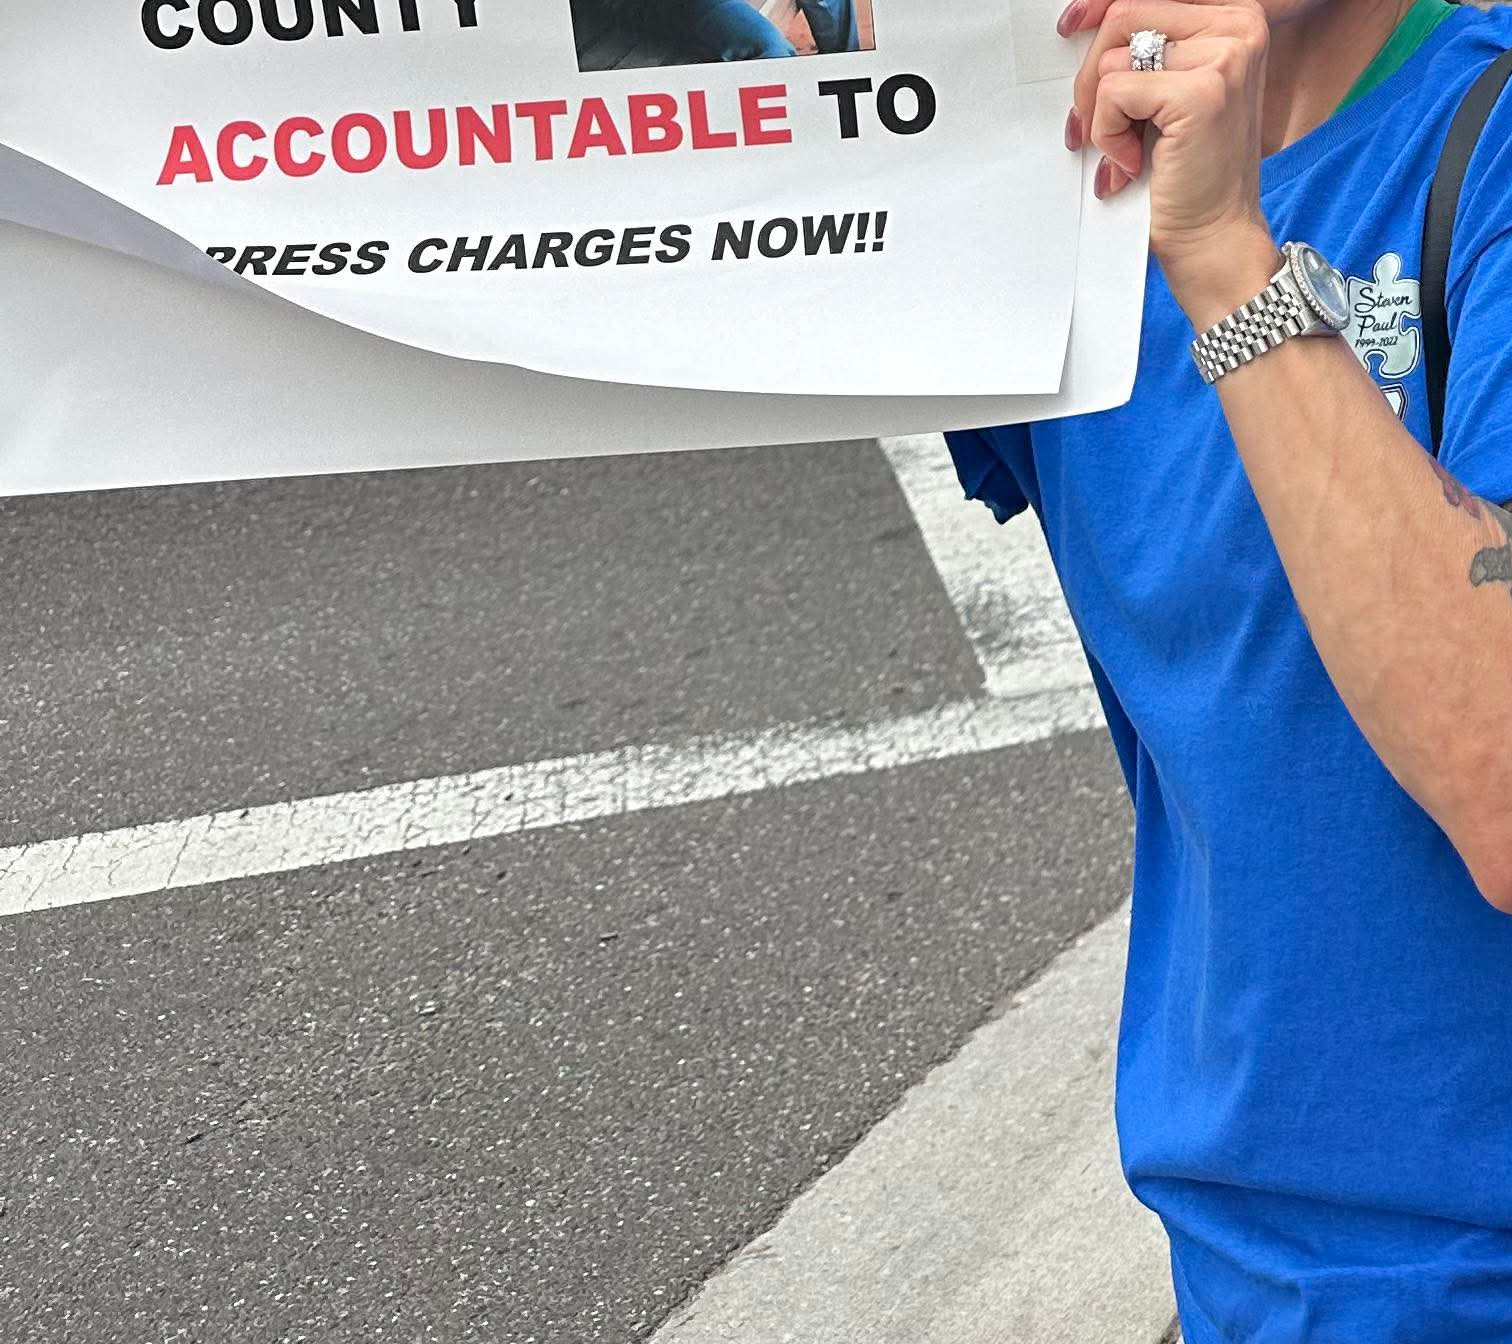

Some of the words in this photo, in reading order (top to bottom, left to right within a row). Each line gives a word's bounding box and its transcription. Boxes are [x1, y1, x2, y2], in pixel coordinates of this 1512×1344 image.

[156, 84, 793, 186] ACCOUNTABLE
[817, 73, 937, 140] TO
[407, 224, 692, 274] CHARGES
[711, 210, 888, 261] NOW!!
[1354, 286, 1414, 314] Steven
[1354, 311, 1398, 338] Paul
